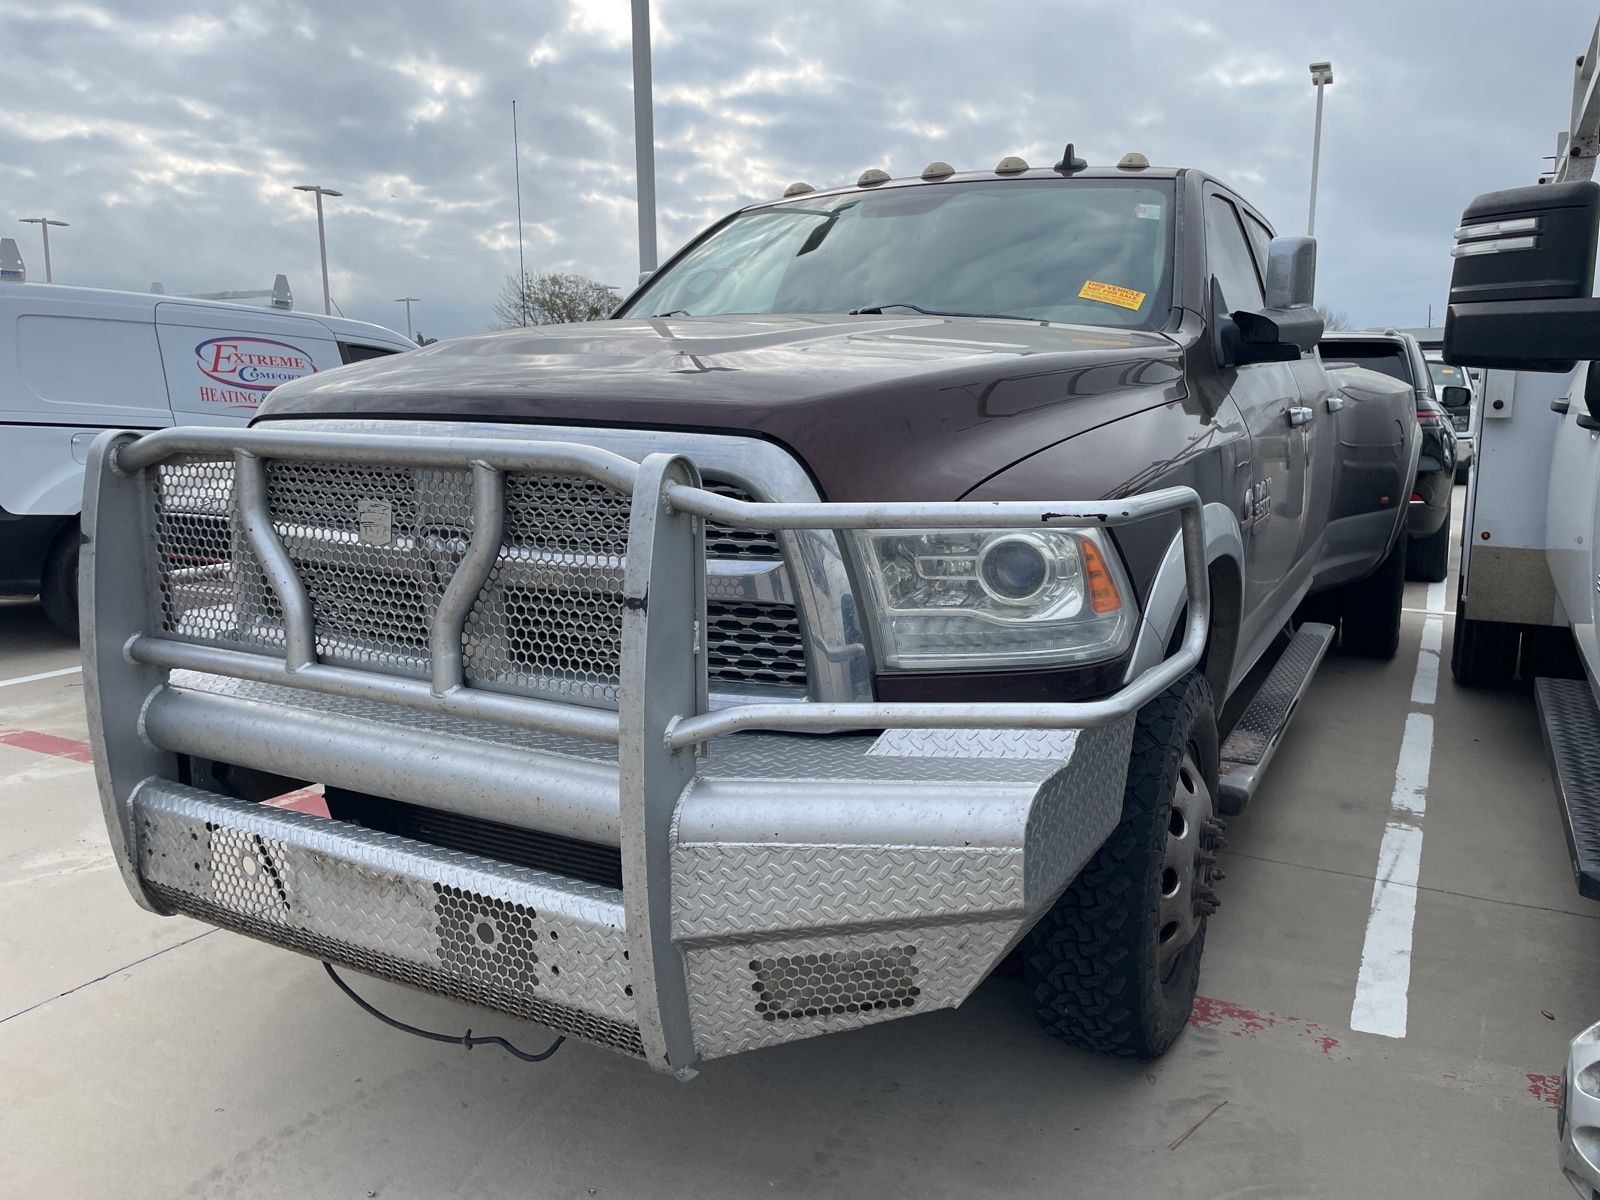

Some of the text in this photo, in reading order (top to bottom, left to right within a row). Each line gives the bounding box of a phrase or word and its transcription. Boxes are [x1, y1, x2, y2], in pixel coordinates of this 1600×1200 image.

[1088, 281, 1141, 297] THIS VEHICLE
[1119, 292, 1137, 300] SALE
[209, 344, 305, 373] EXTREME
[200, 386, 257, 404] HEATING
